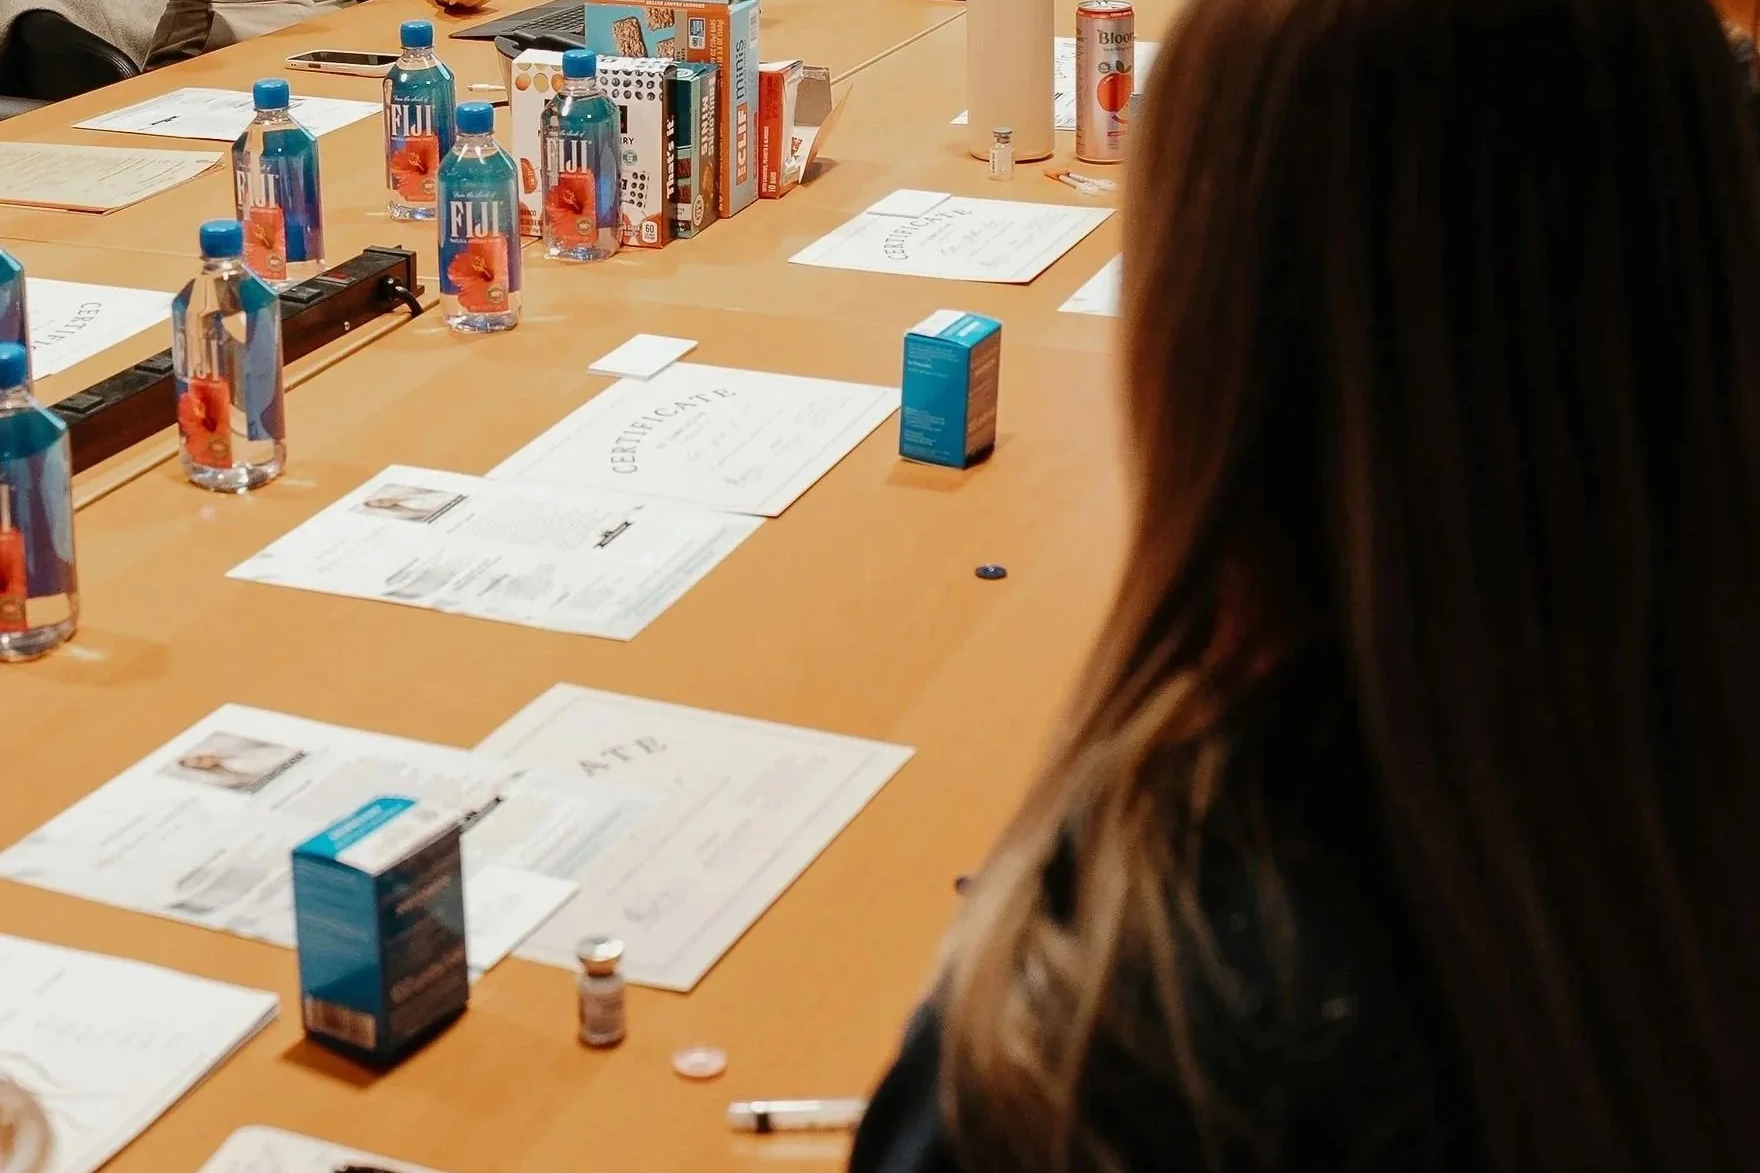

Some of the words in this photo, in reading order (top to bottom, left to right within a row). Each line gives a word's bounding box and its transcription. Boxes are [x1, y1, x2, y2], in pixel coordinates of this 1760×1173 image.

[736, 39, 747, 100] minis
[391, 104, 432, 137] FIJI
[737, 110, 747, 165] CLIF
[546, 137, 588, 173] FIJI
[666, 140, 675, 199] That's
[767, 184, 777, 192] 10
[450, 201, 500, 238] FIJI
[645, 224, 655, 233] 60
[883, 208, 973, 260] CERTIFICATE
[32, 302, 102, 350] CERTIFI
[610, 387, 737, 475] CERTIFICATE
